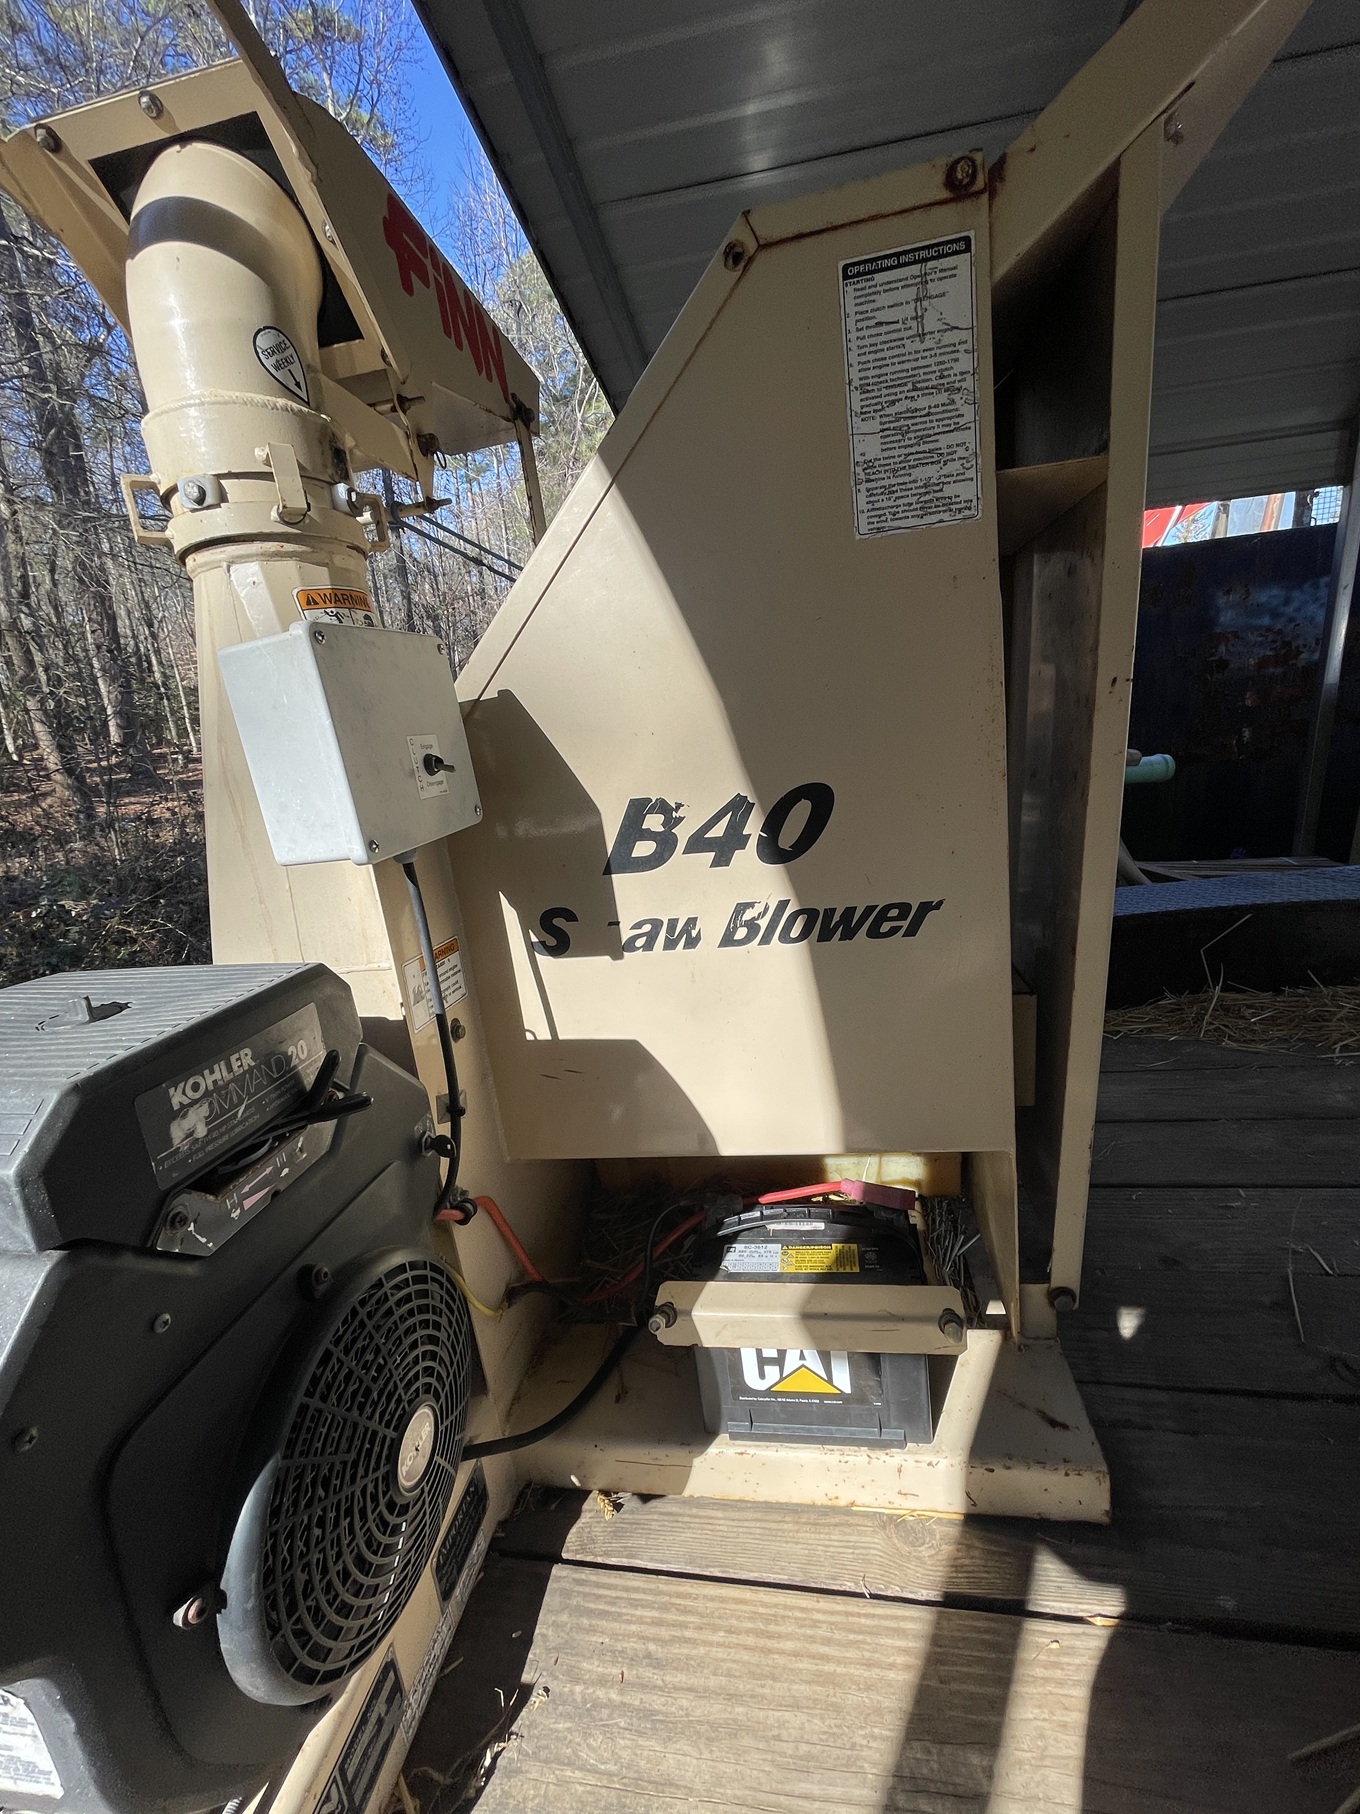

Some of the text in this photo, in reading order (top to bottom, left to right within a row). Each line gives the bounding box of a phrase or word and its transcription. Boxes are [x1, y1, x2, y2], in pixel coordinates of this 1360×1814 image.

[847, 241, 965, 275] OPERATING INSTRUCTIONS
[844, 275, 875, 287] STARTING
[878, 276, 908, 287] understand
[261, 340, 290, 360] SERVICE
[271, 354, 296, 372] WEEKLY
[409, 738, 424, 792] CLUTCH
[602, 781, 836, 876] B40
[530, 897, 946, 957] Saw Blower
[434, 943, 455, 959] ARNING
[168, 1047, 256, 1111] KOHLER
[180, 1054, 286, 1122] OMMAND
[287, 1039, 308, 1069] 20
